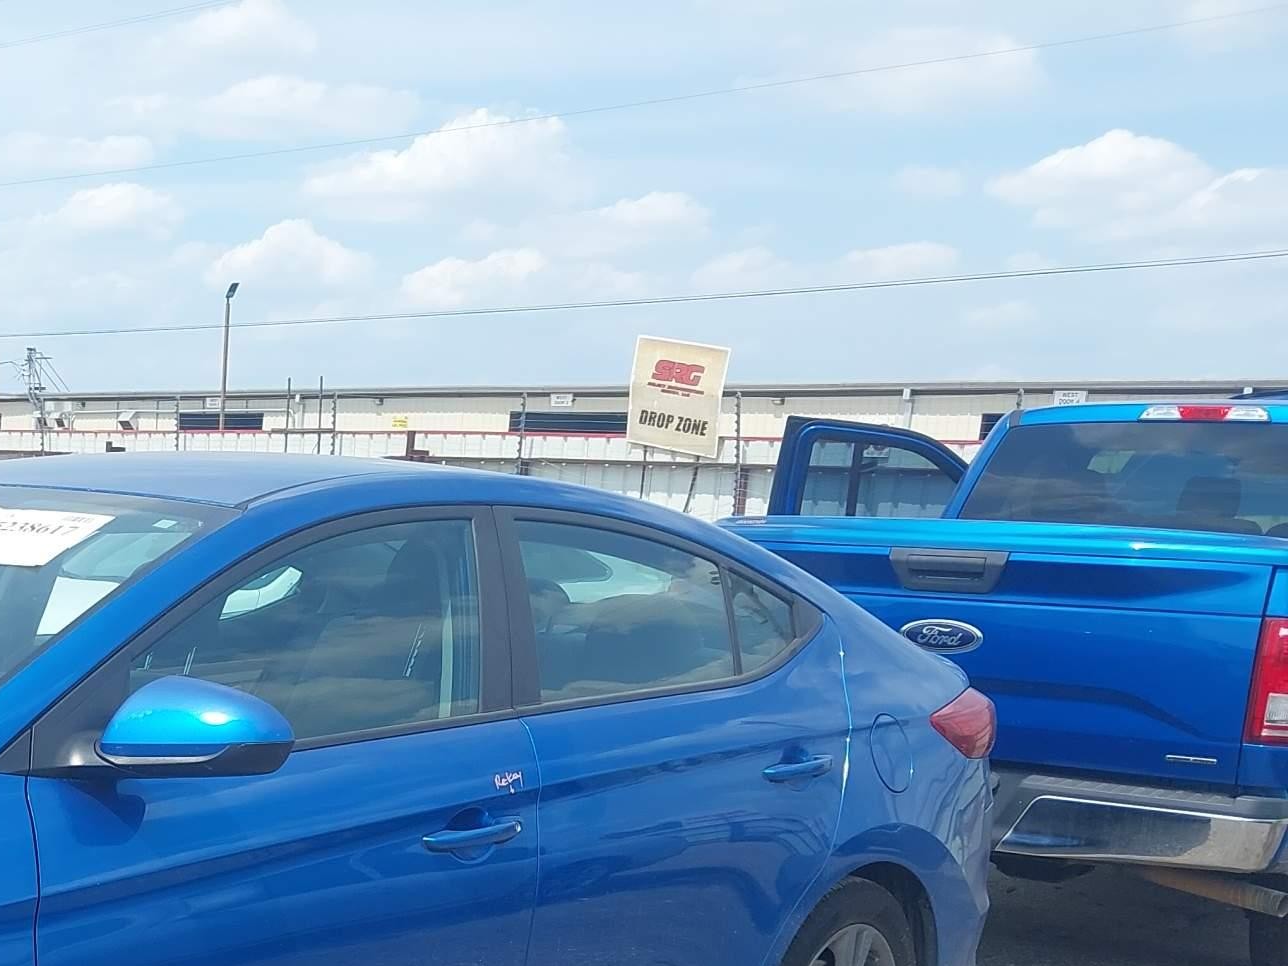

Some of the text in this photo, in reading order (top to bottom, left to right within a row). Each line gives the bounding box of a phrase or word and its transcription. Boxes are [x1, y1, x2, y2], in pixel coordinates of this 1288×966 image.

[651, 359, 705, 387] SRG
[638, 409, 709, 437] DROP ZONE
[917, 625, 963, 646] Ford
